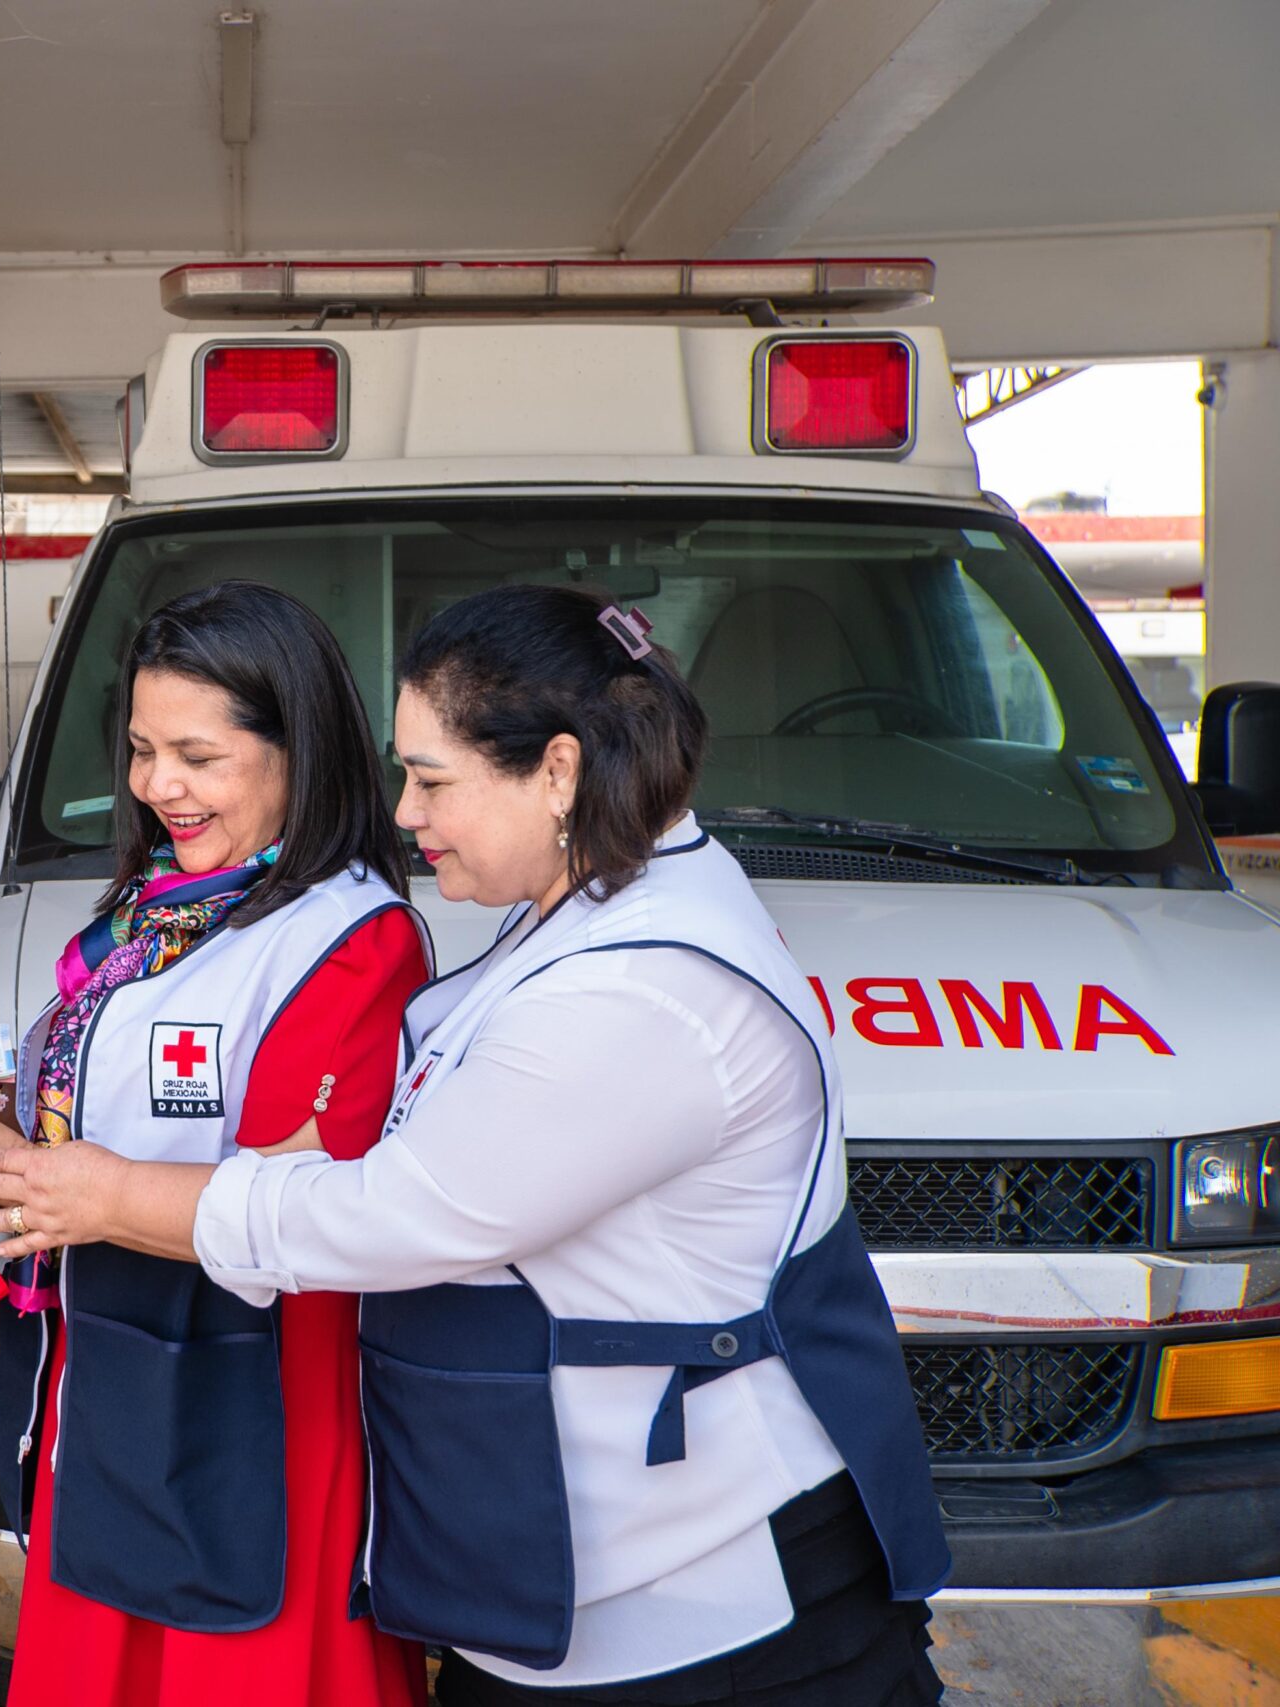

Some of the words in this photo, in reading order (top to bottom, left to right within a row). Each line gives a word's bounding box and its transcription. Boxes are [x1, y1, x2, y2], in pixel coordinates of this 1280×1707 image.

[162, 1079, 184, 1089] CRUZ
[186, 1080, 208, 1089] ROJA
[163, 1089, 209, 1098] MEXICANA
[158, 1101, 218, 1113] DAMAS
